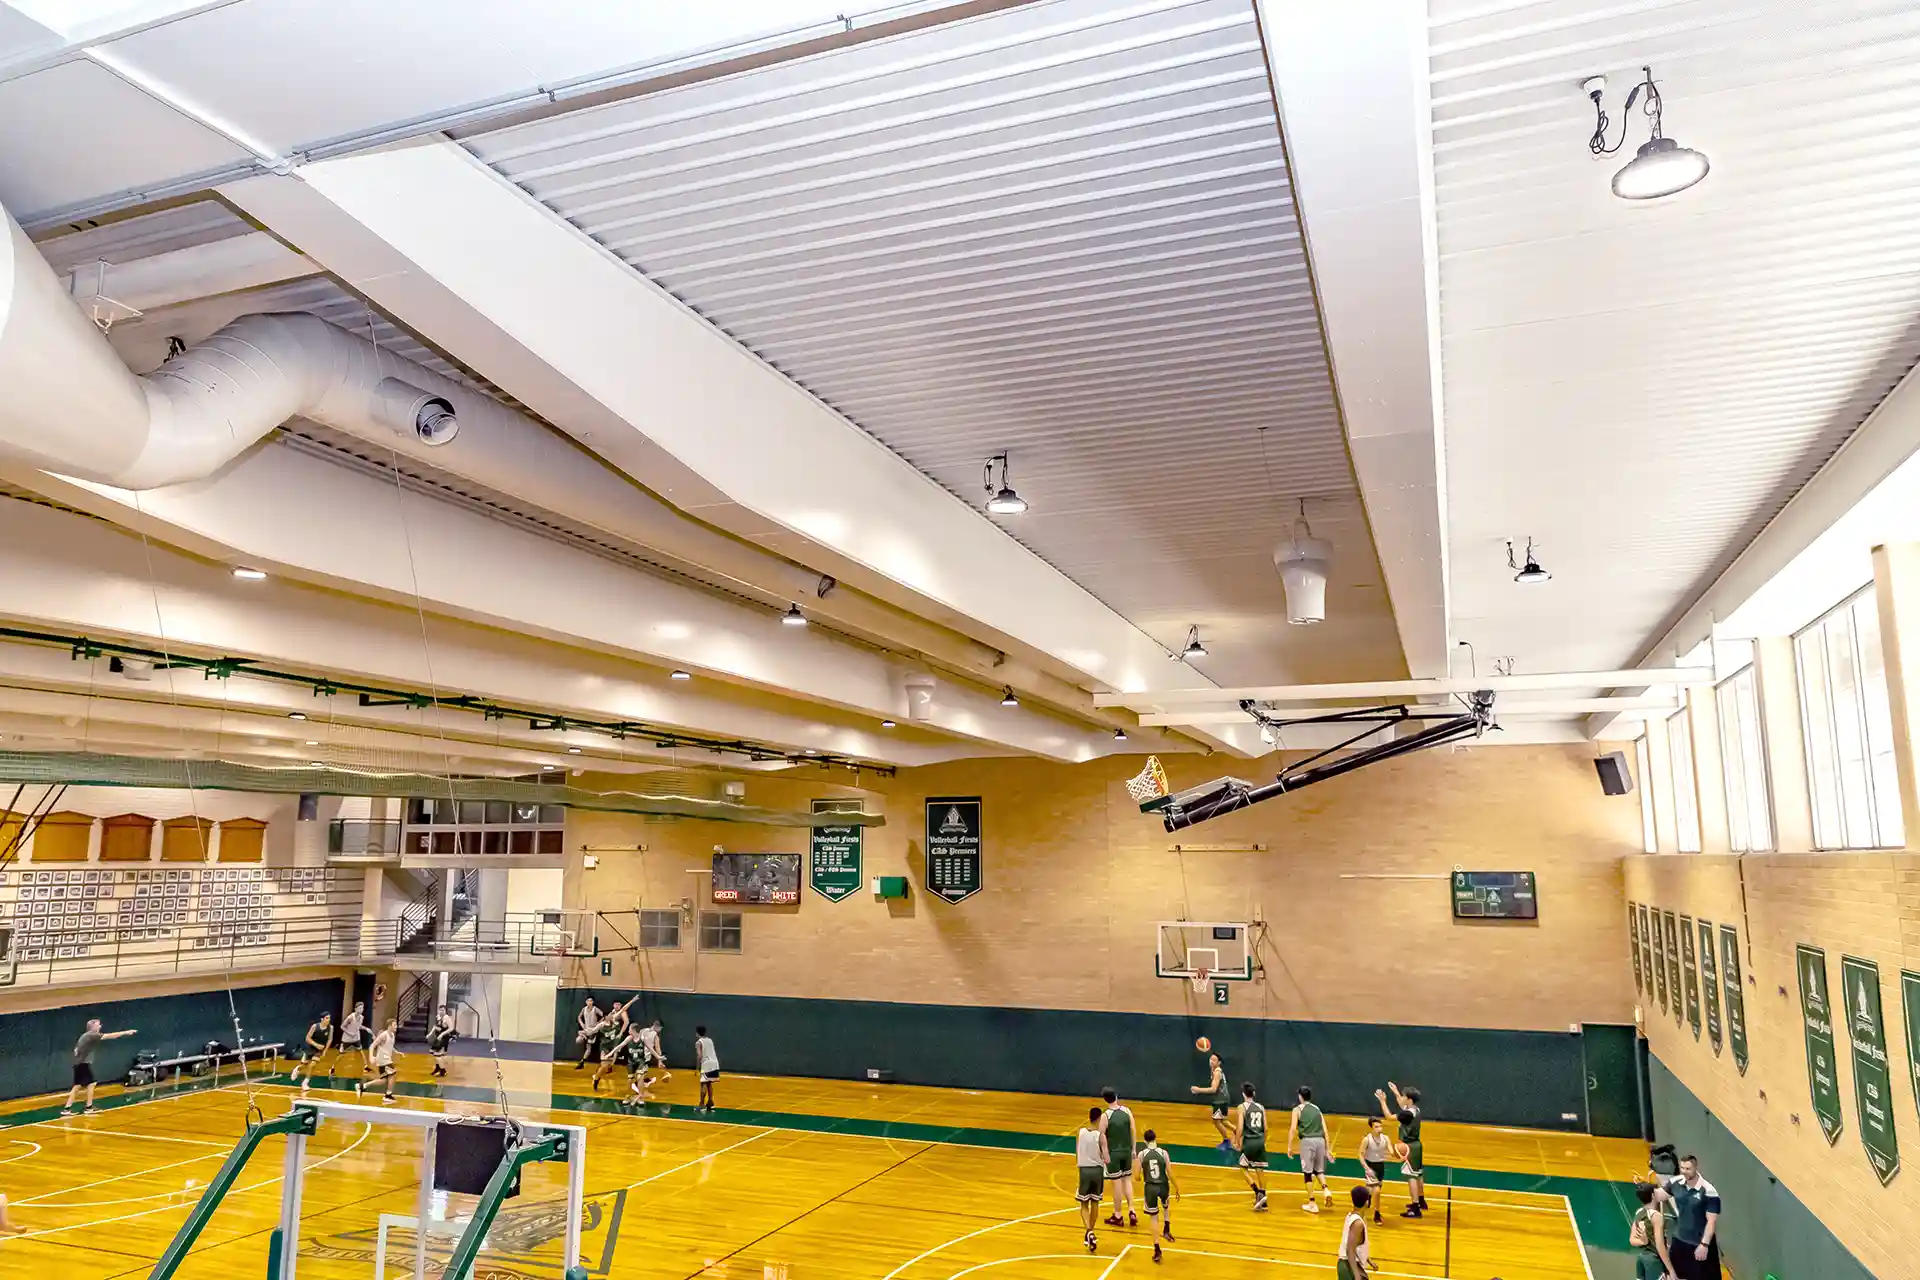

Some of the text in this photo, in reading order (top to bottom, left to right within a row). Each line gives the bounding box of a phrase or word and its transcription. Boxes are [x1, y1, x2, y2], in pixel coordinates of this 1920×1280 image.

[714, 891, 738, 899] GREEN
[1217, 989, 1226, 1001] 2
[1250, 1111, 1262, 1127] 23
[1149, 1159, 1160, 1179] 5
